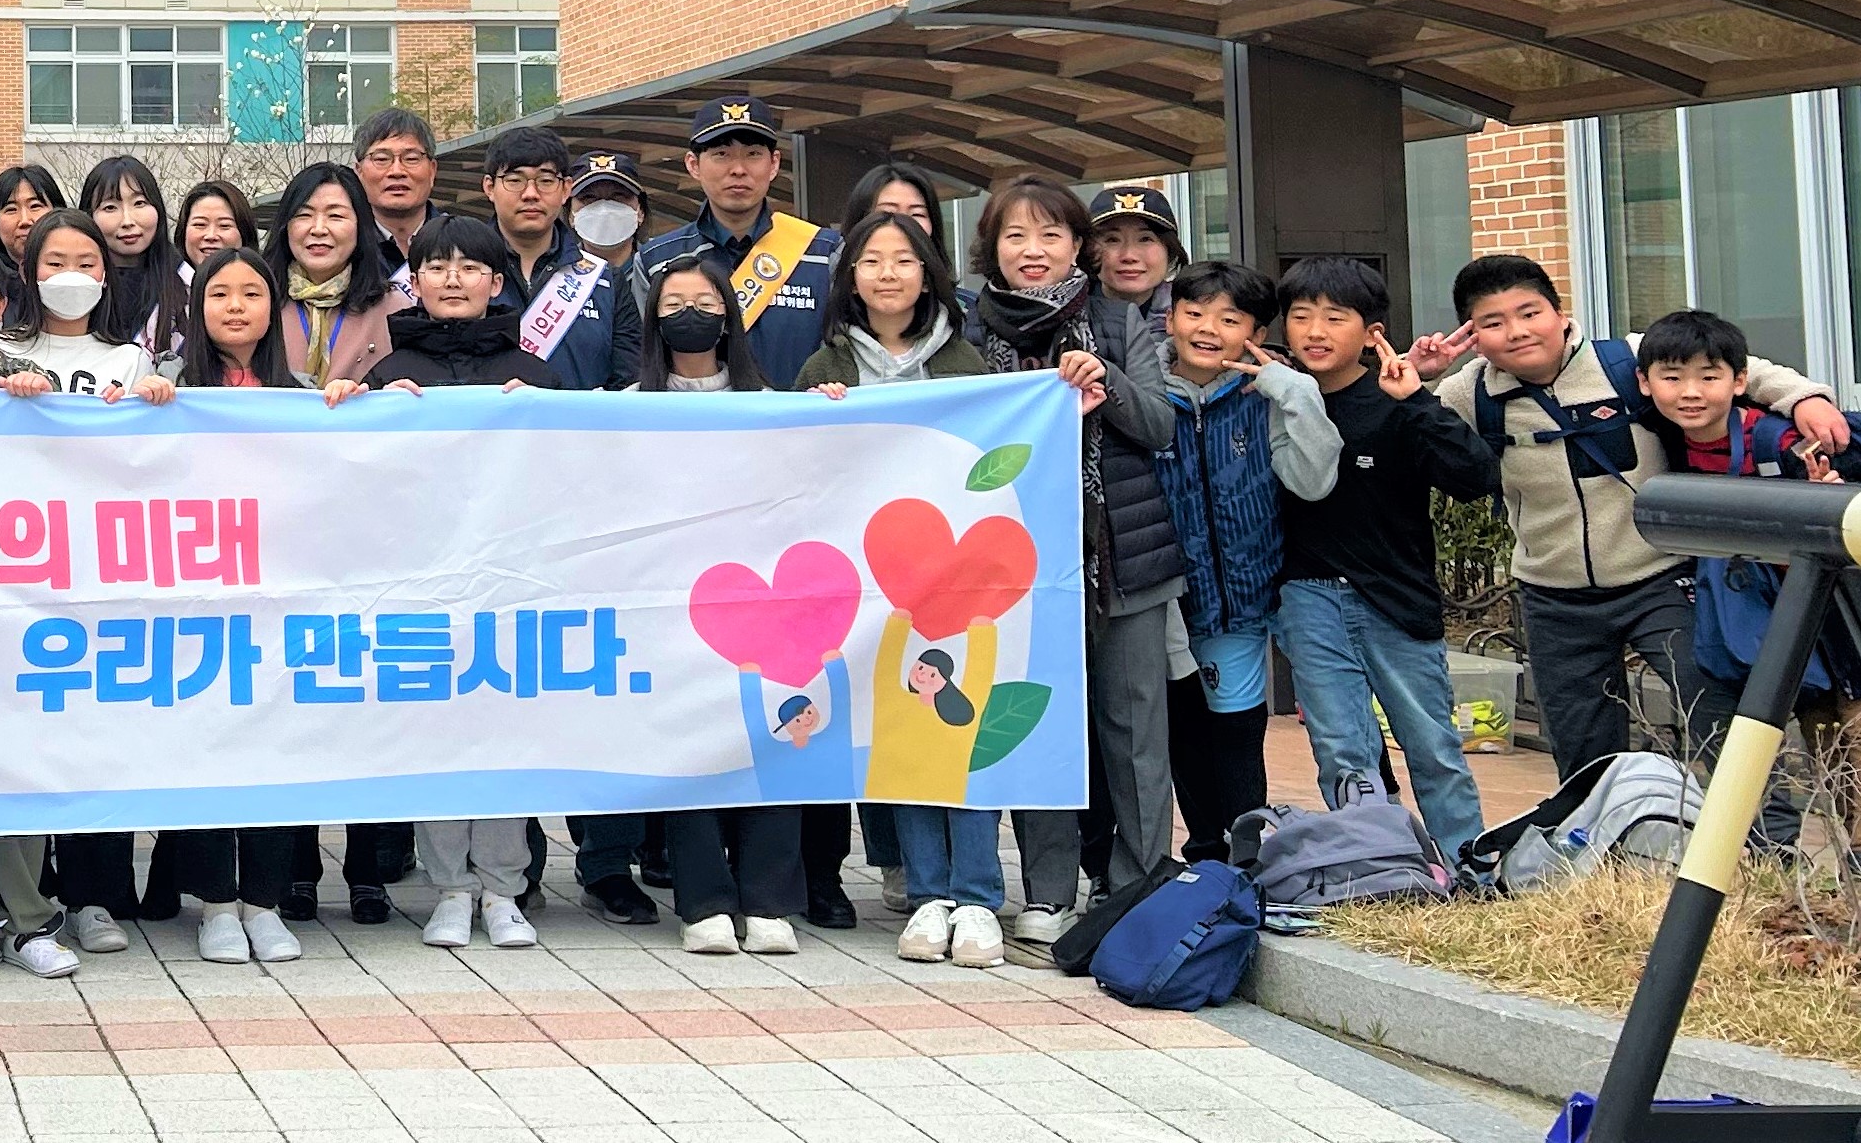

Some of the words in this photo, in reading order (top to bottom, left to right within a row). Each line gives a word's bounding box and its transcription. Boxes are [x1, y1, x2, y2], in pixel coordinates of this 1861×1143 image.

[95, 498, 260, 588] 미래
[16, 614, 262, 712] 우리가
[284, 607, 652, 705] 만듭시다.
